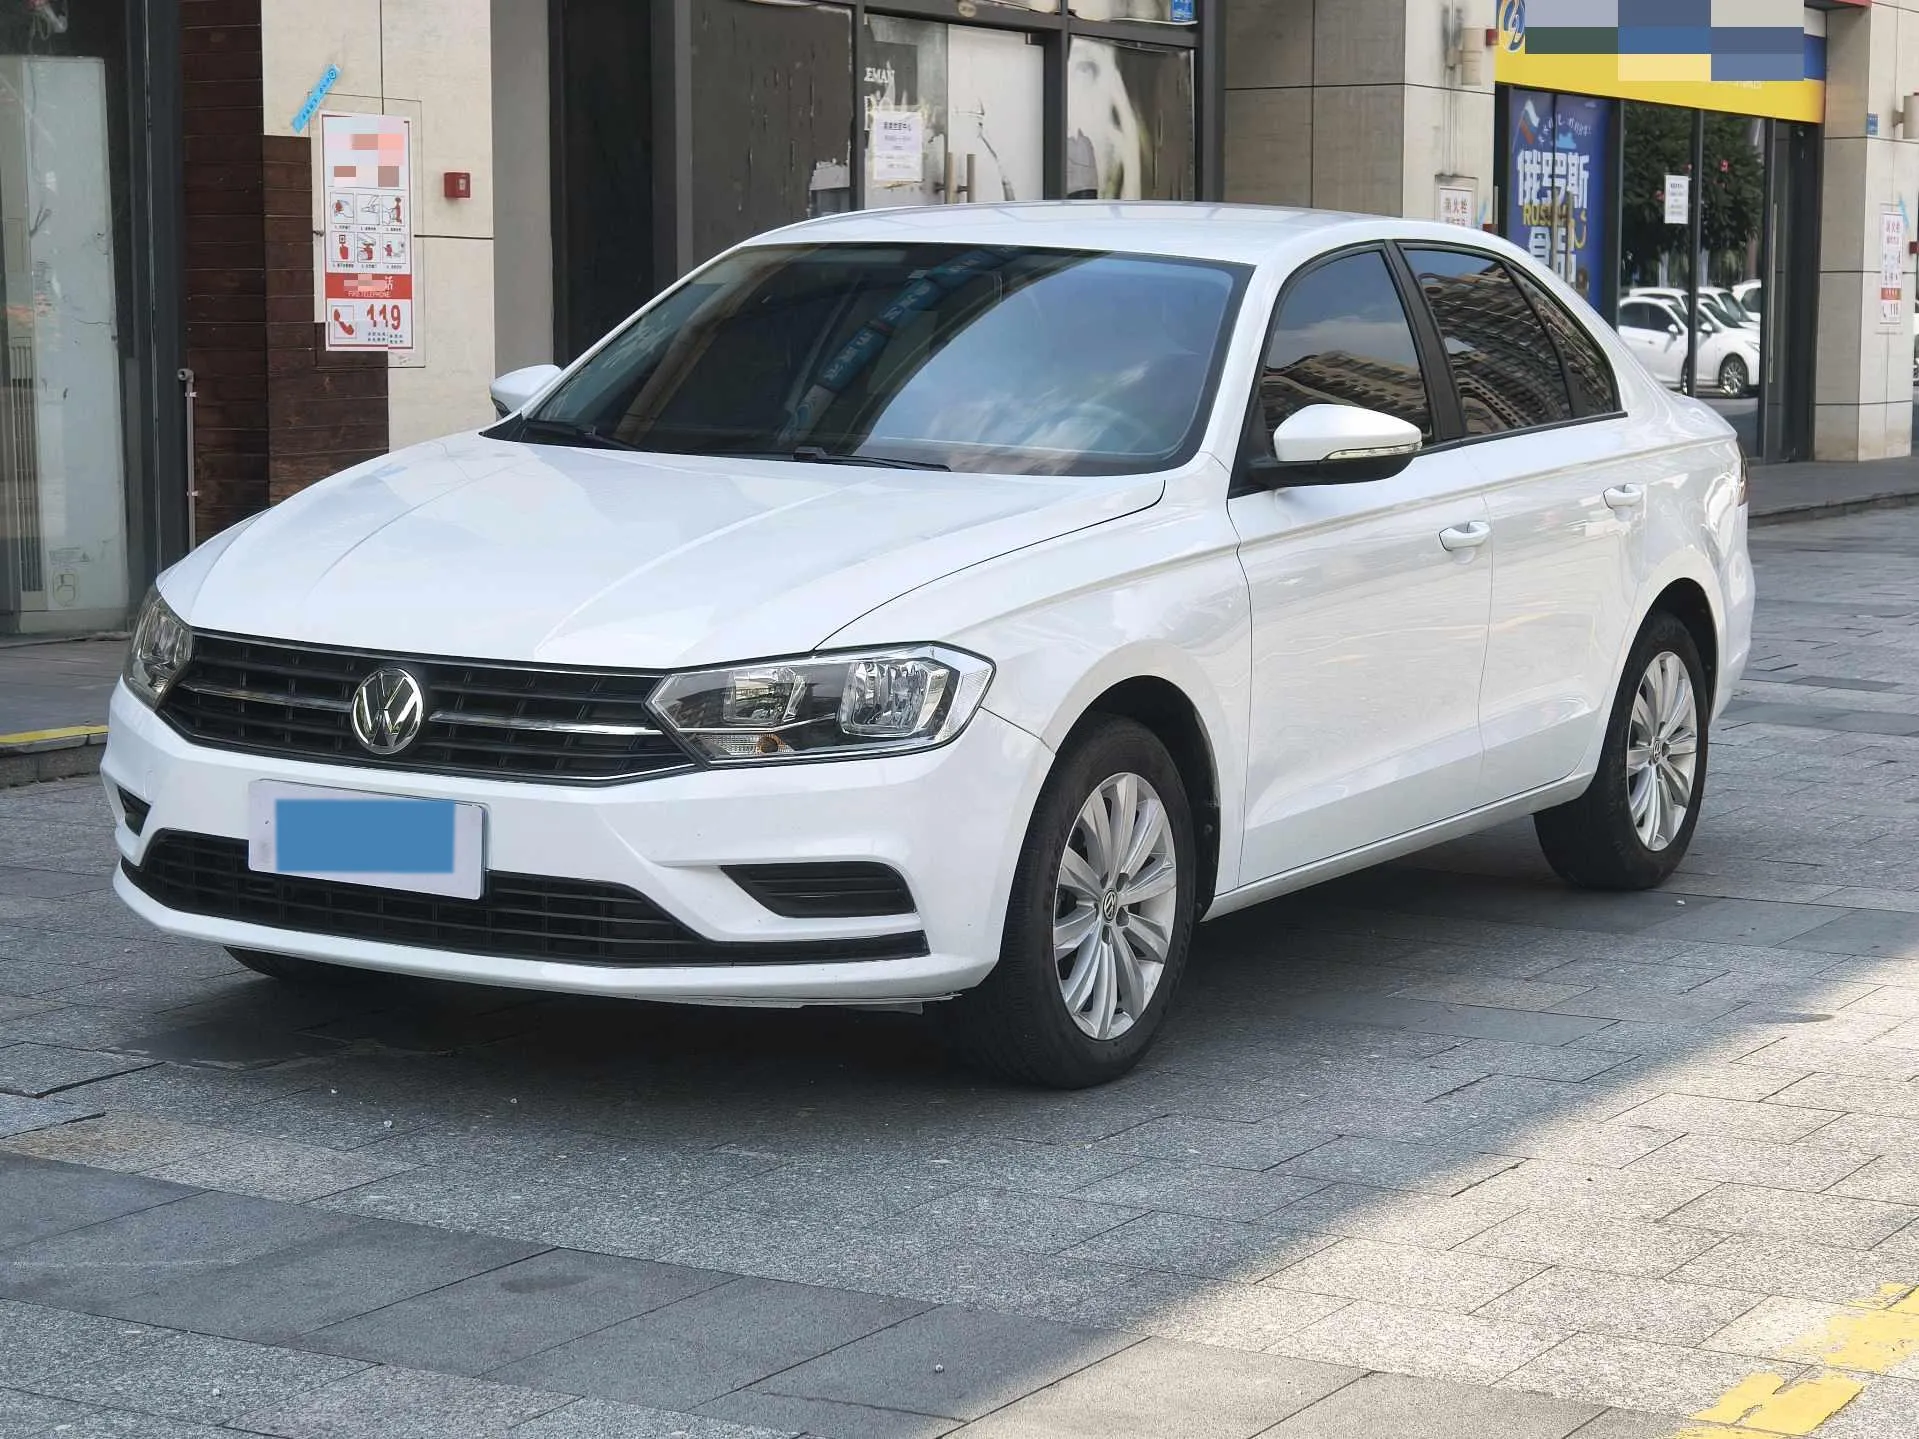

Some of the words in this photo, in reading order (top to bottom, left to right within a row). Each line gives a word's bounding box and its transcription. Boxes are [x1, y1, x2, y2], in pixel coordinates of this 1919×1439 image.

[1517, 149, 1589, 208] 俄罗斯
[366, 303, 401, 330] 119
